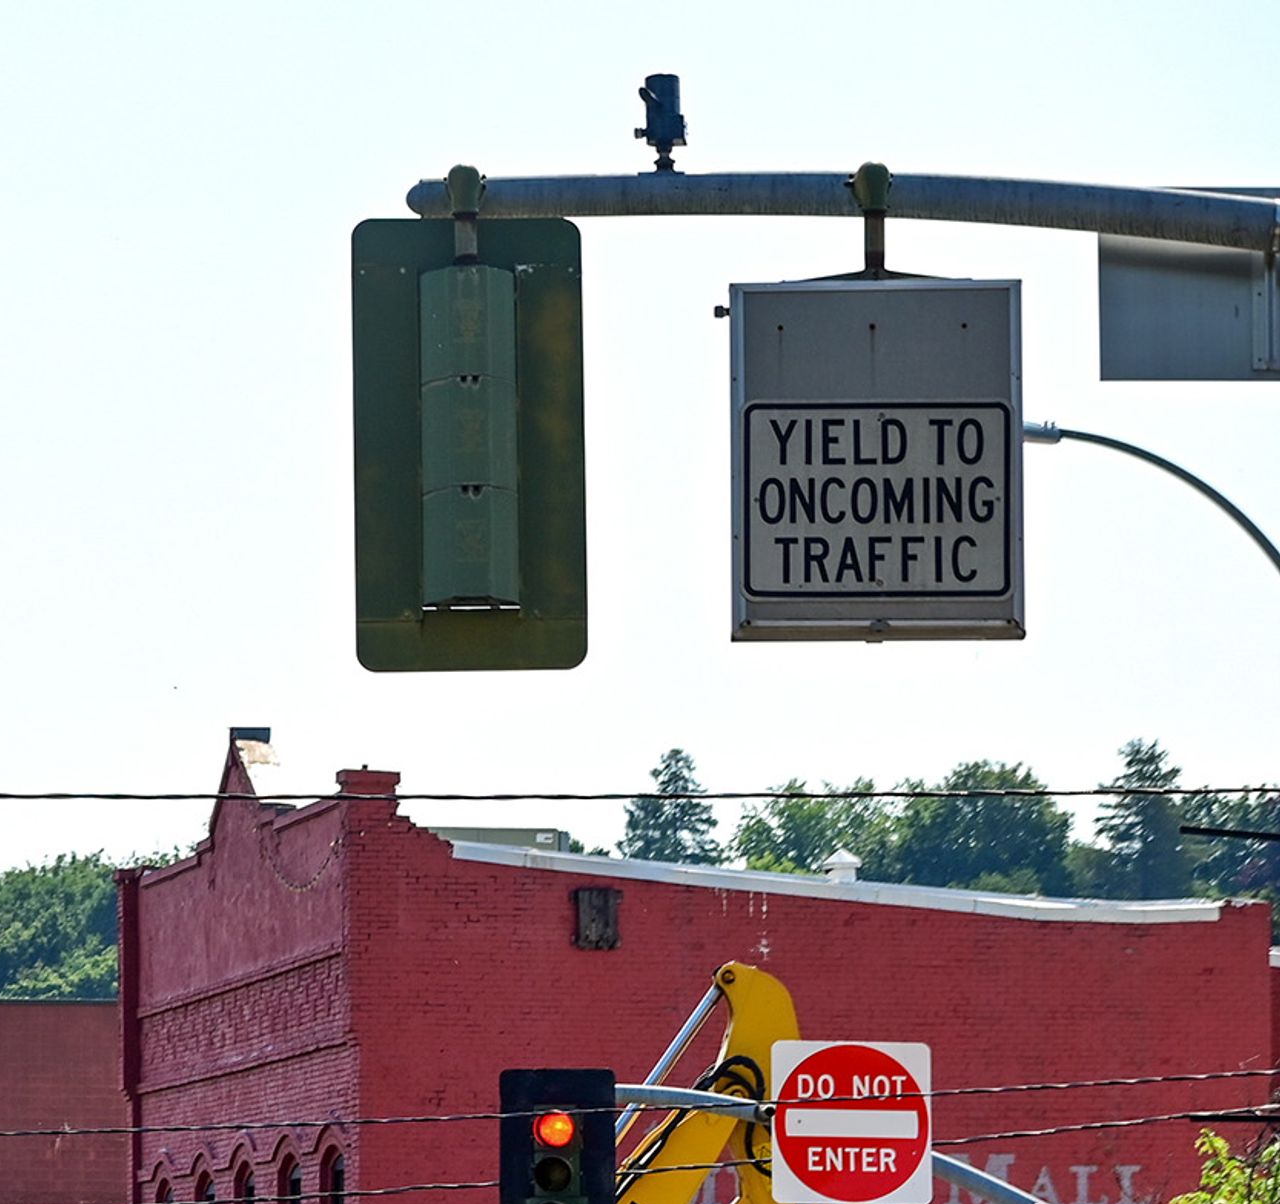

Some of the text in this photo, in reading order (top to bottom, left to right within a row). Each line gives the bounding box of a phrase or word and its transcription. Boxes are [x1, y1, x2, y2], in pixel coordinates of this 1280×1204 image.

[768, 417, 985, 466] YIELD TO
[758, 476, 995, 525] ONCOMING
[774, 536, 978, 584] TRAFFIC
[796, 1073, 907, 1101] DO NOT
[807, 1146, 897, 1173] ENTER
